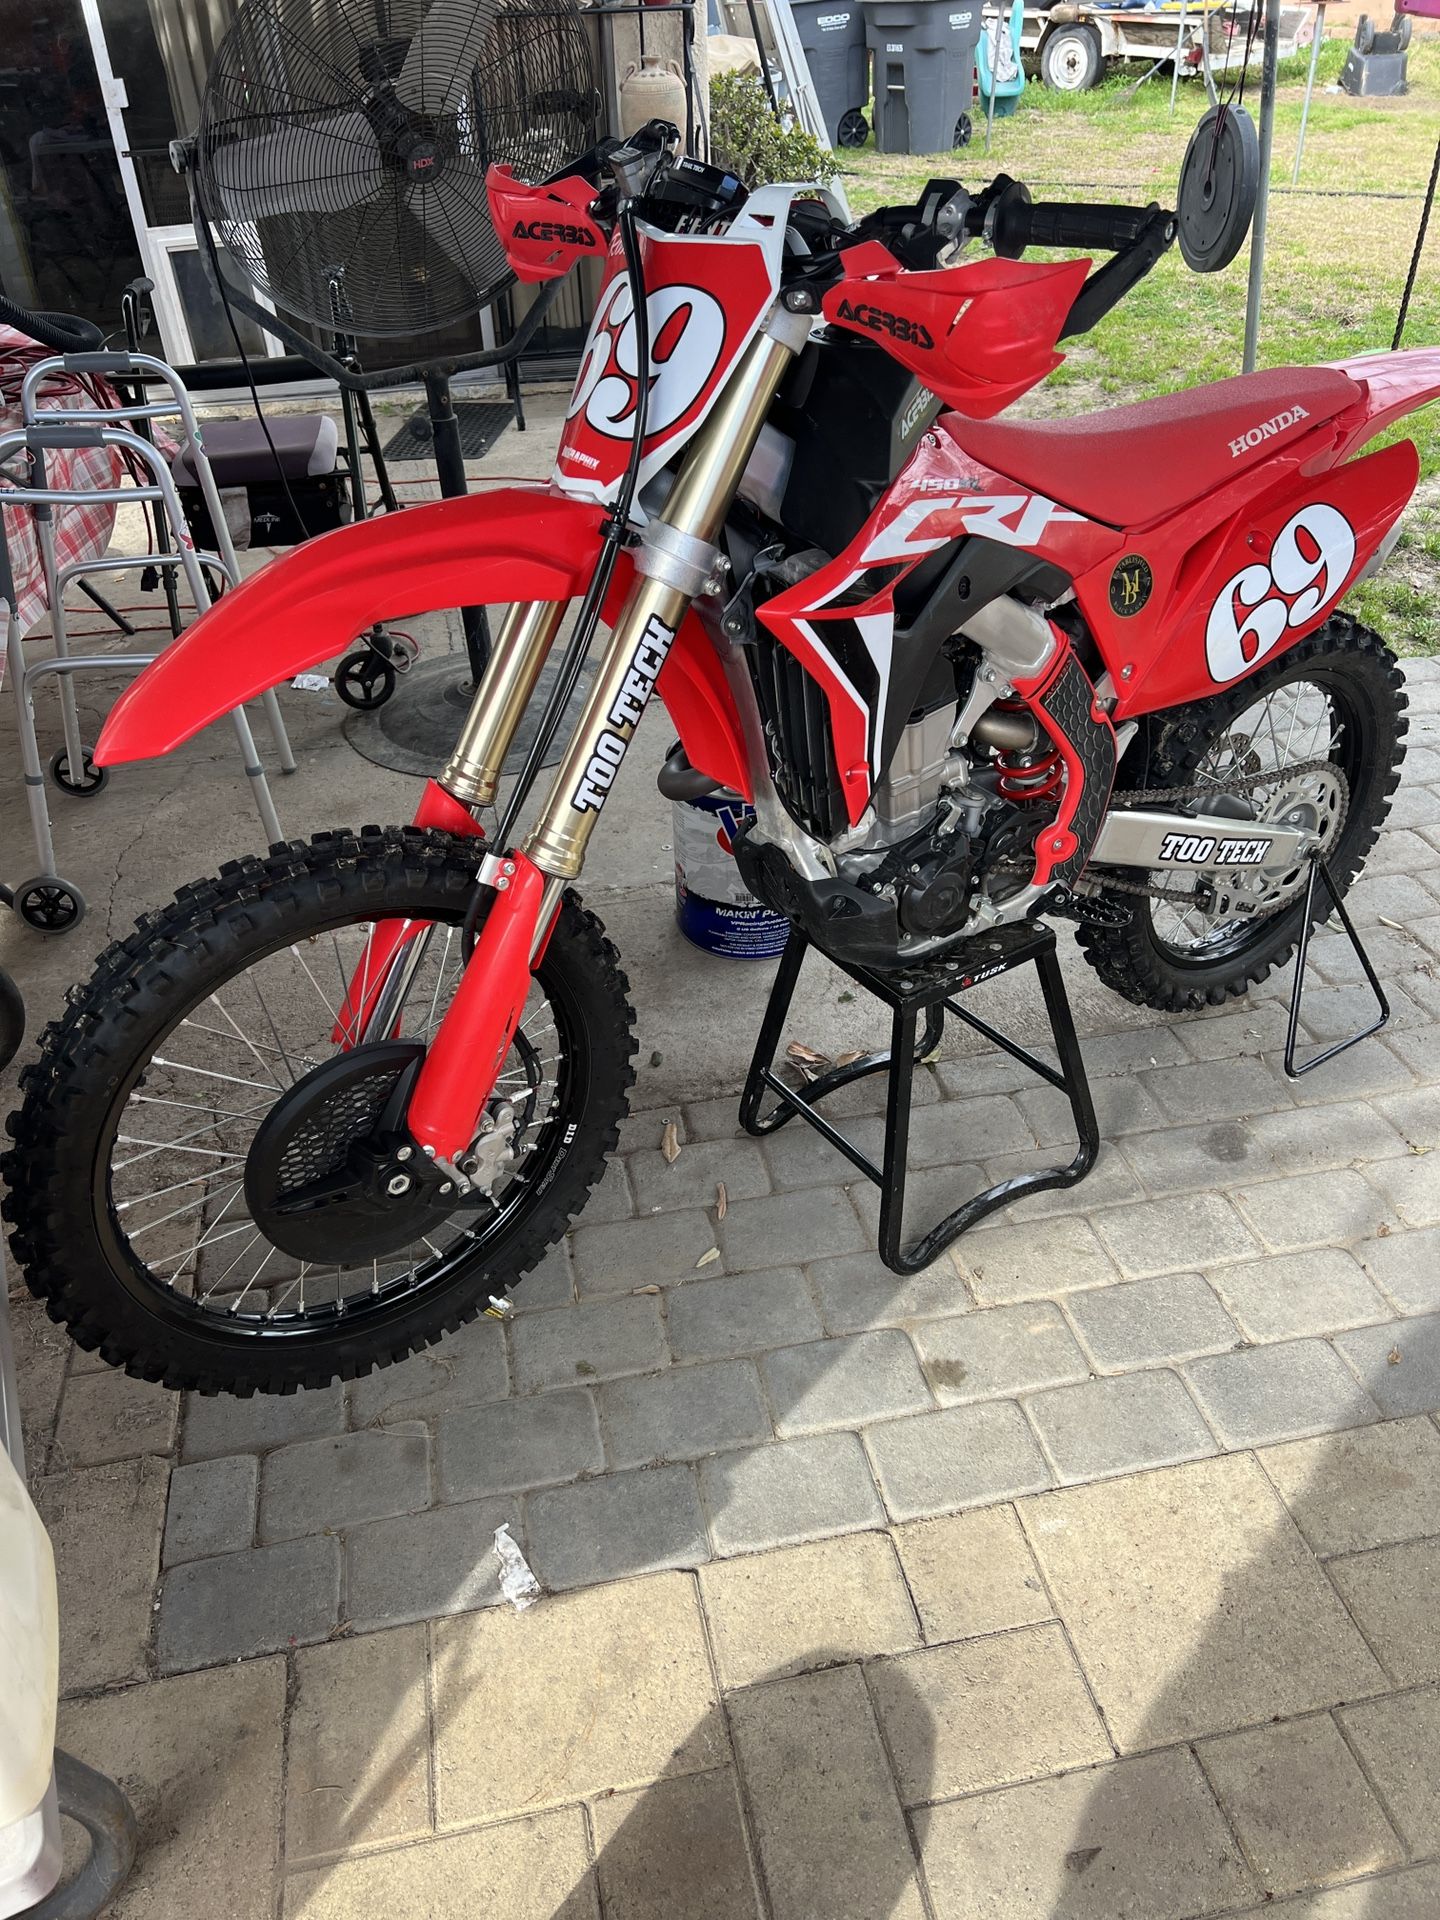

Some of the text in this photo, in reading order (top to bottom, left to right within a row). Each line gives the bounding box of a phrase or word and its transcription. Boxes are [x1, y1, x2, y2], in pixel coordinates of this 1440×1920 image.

[817, 13, 850, 25] EDCO
[413, 157, 434, 170] HDX
[512, 220, 596, 247] ACERBIS
[836, 299, 935, 350] ACERBIS
[565, 269, 728, 442] 69
[1228, 405, 1310, 458] HONDA
[1205, 502, 1357, 684] 69
[571, 614, 676, 813] TOO TECH
[1160, 833, 1272, 864] TOO TECH
[973, 962, 1007, 982] TUSK
